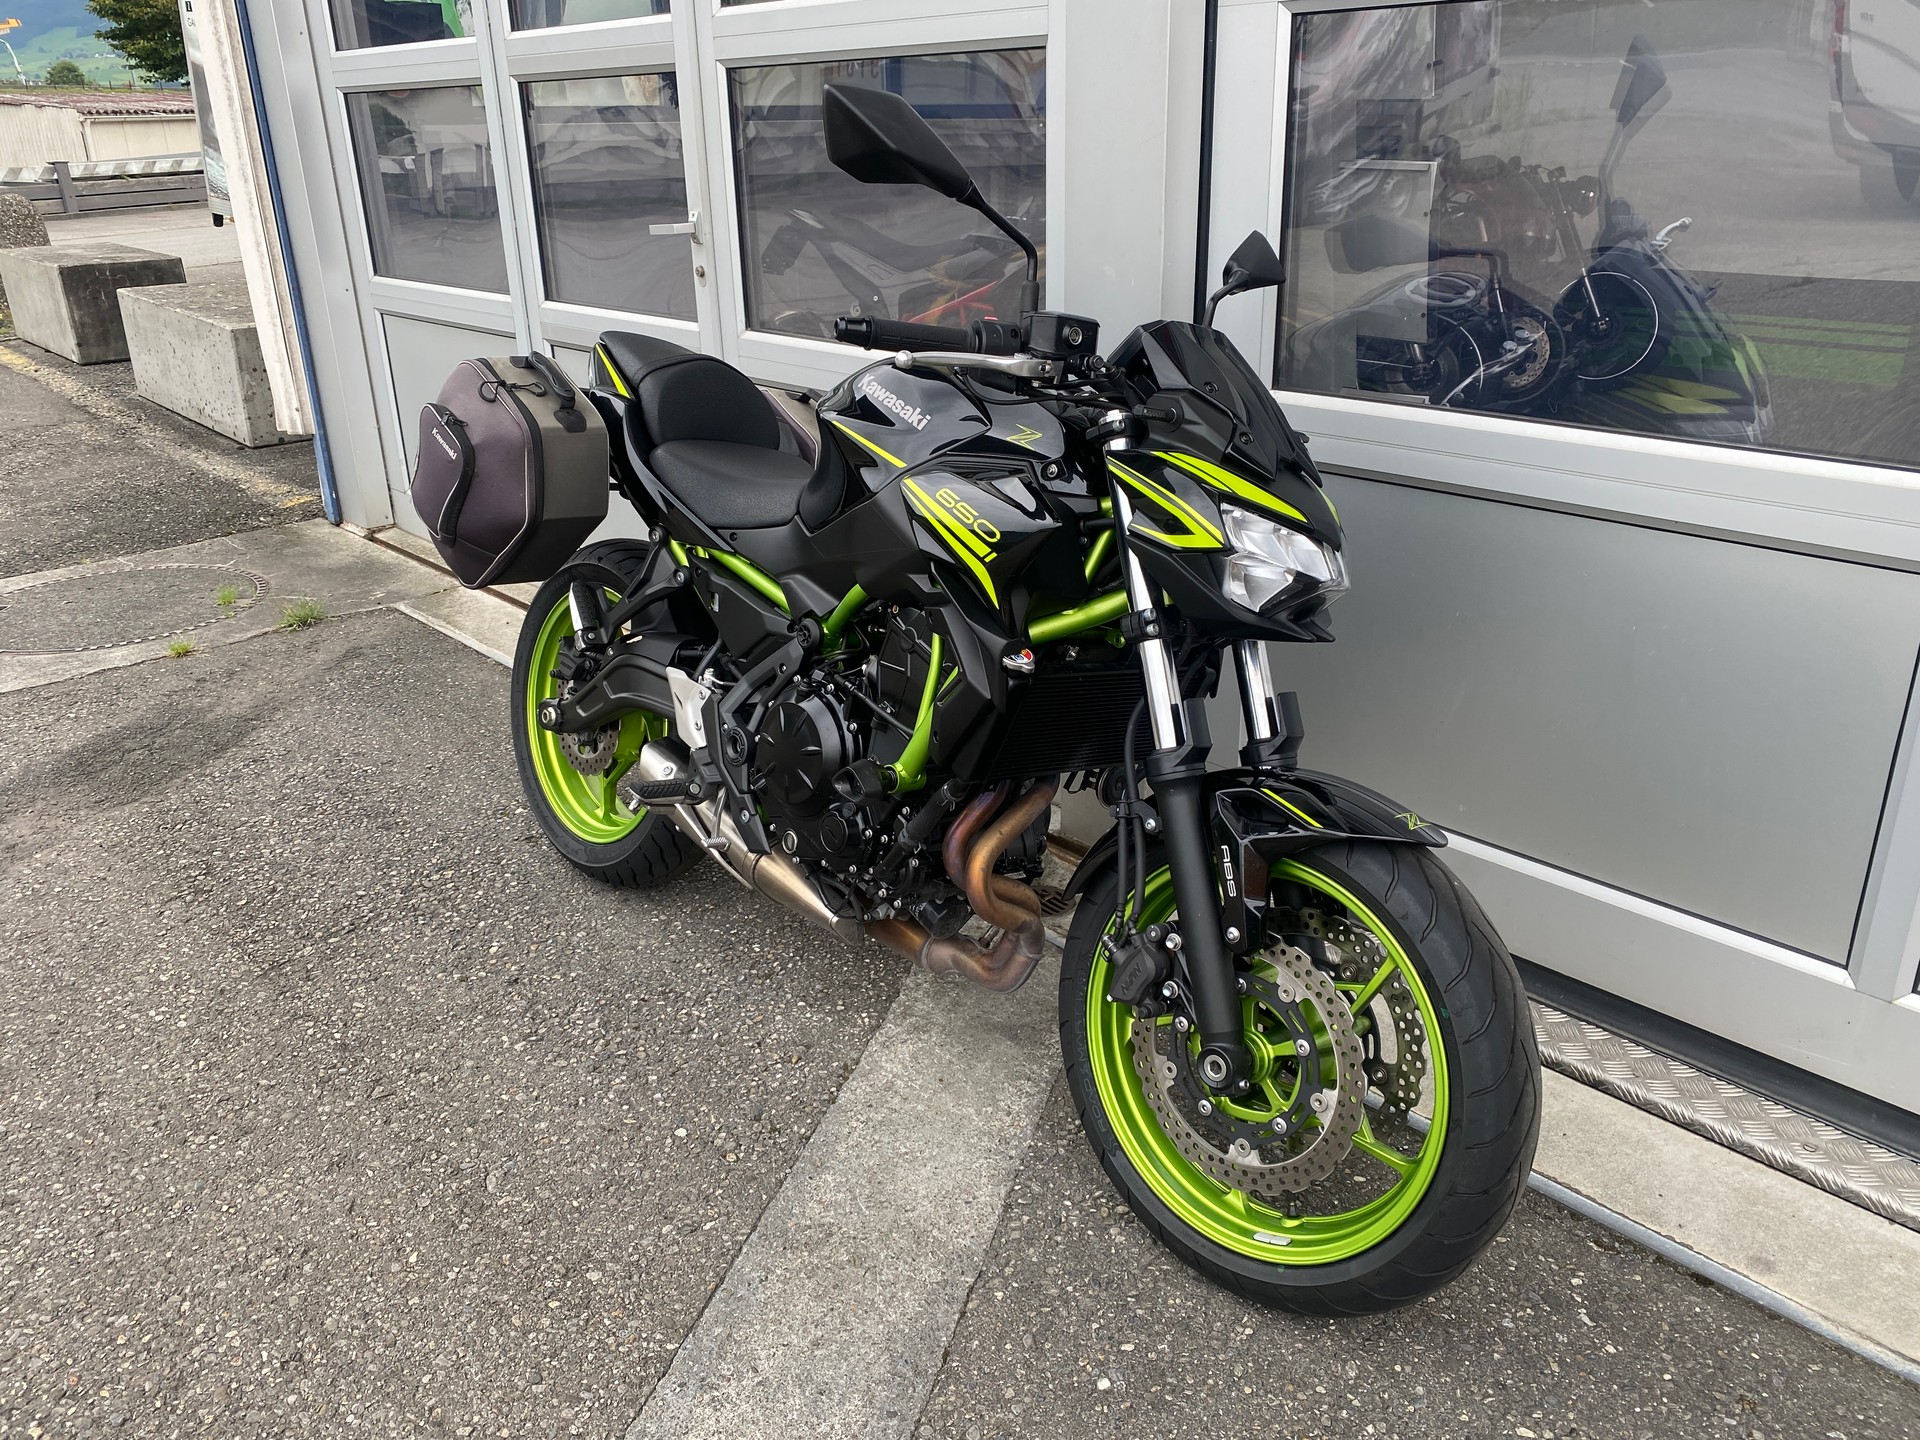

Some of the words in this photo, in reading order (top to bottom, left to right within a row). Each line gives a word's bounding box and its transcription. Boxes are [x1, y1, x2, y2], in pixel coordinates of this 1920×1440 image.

[857, 373, 932, 431] Kawasaki
[431, 427, 457, 460] Kawasaki
[935, 487, 1001, 543] 650
[1220, 844, 1237, 897] ABS
